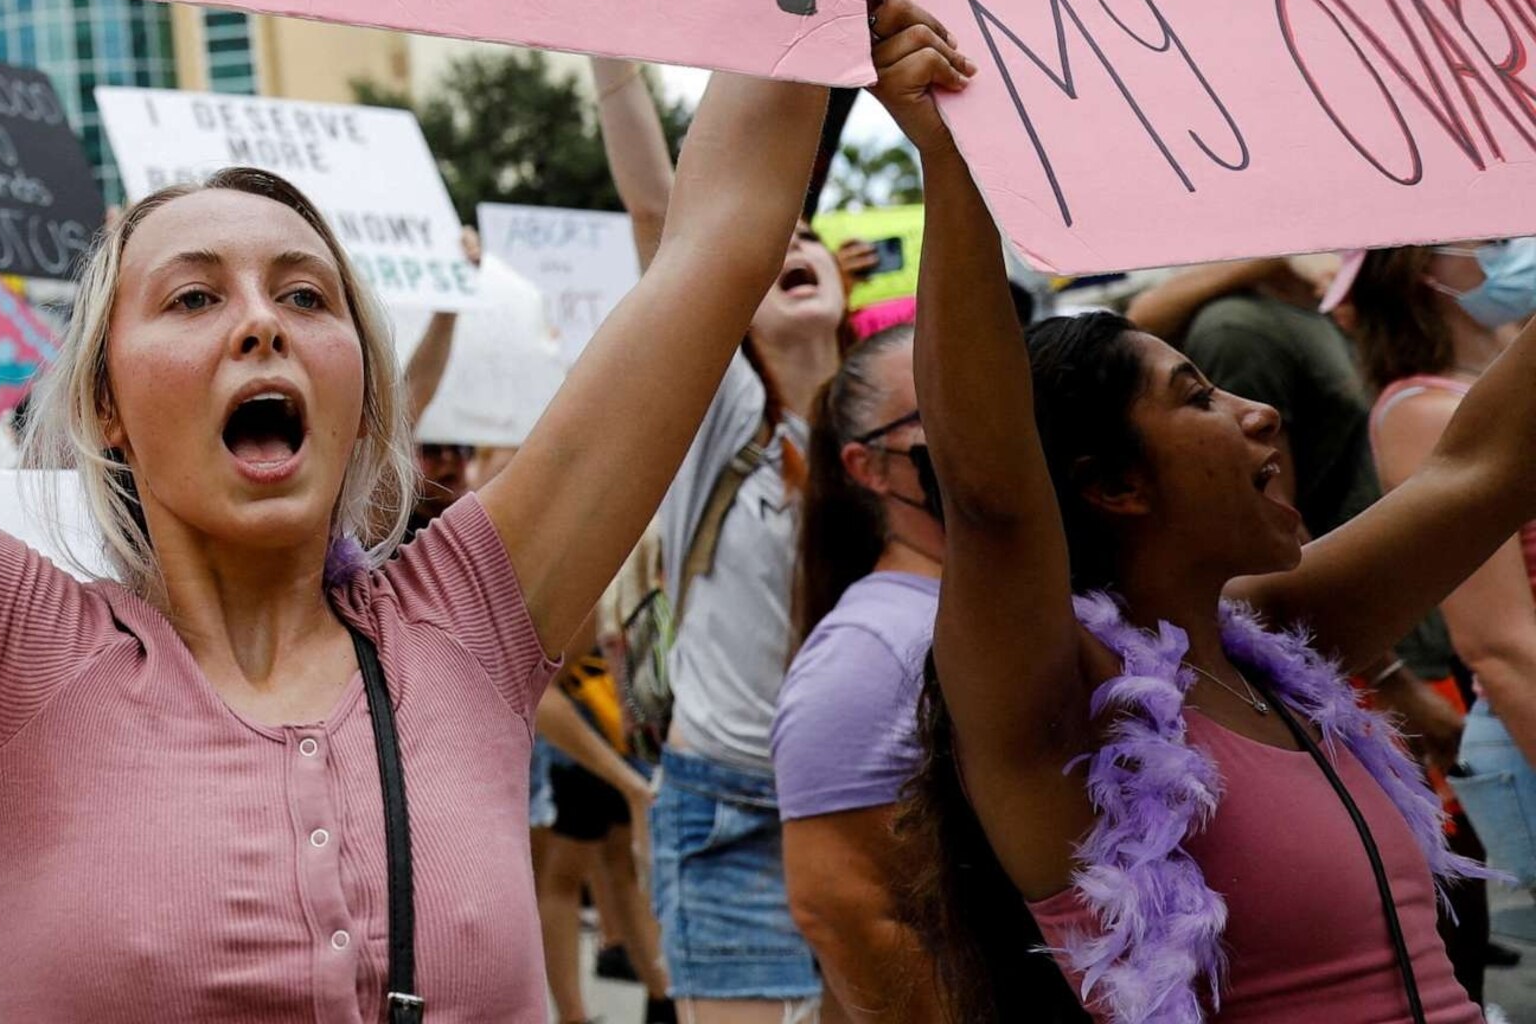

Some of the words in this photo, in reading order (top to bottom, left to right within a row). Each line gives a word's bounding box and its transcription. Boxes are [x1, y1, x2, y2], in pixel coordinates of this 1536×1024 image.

[145, 98, 161, 125] I
[192, 100, 370, 144] DESERVE
[226, 136, 330, 173] MORE
